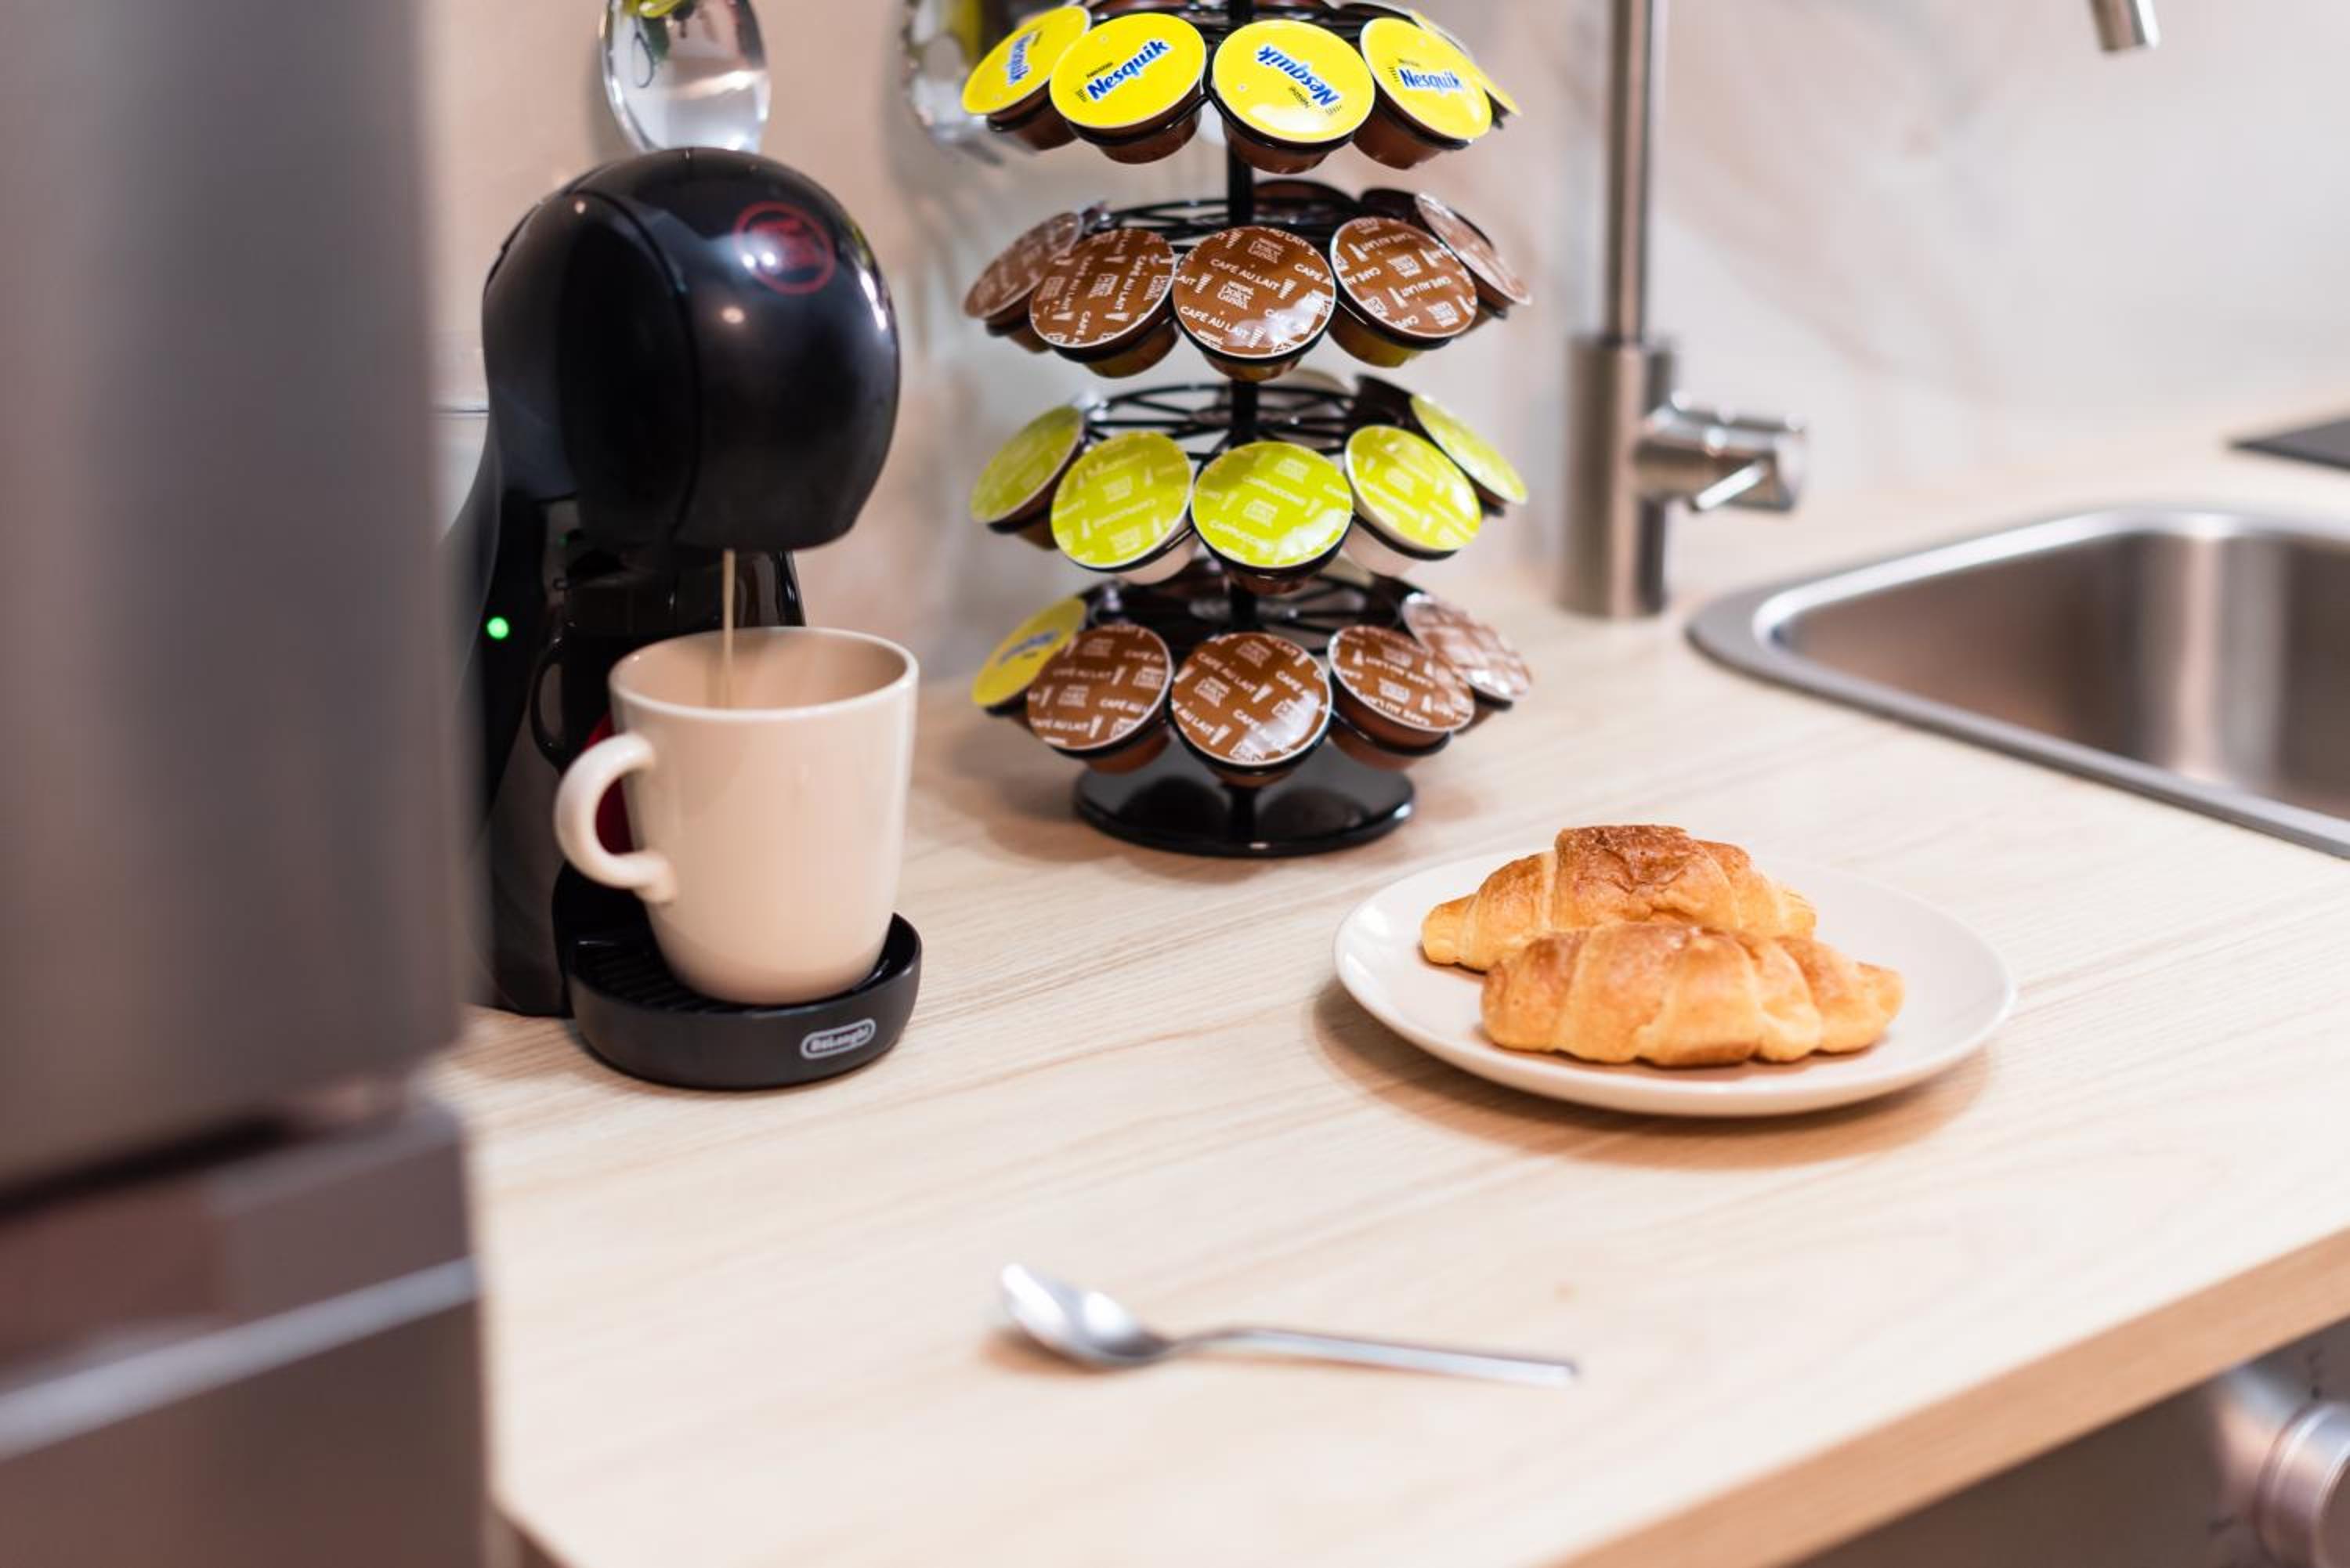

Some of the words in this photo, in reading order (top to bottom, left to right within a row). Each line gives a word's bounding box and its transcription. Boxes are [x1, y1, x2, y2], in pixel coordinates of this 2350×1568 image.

[1086, 40, 1170, 100] Nesquik
[1257, 45, 1340, 105] Nesquik
[1398, 68, 1462, 92] Nesquik
[1238, 270, 1256, 280] AU
[1253, 275, 1282, 291] LAIT
[1209, 317, 1225, 329] AU
